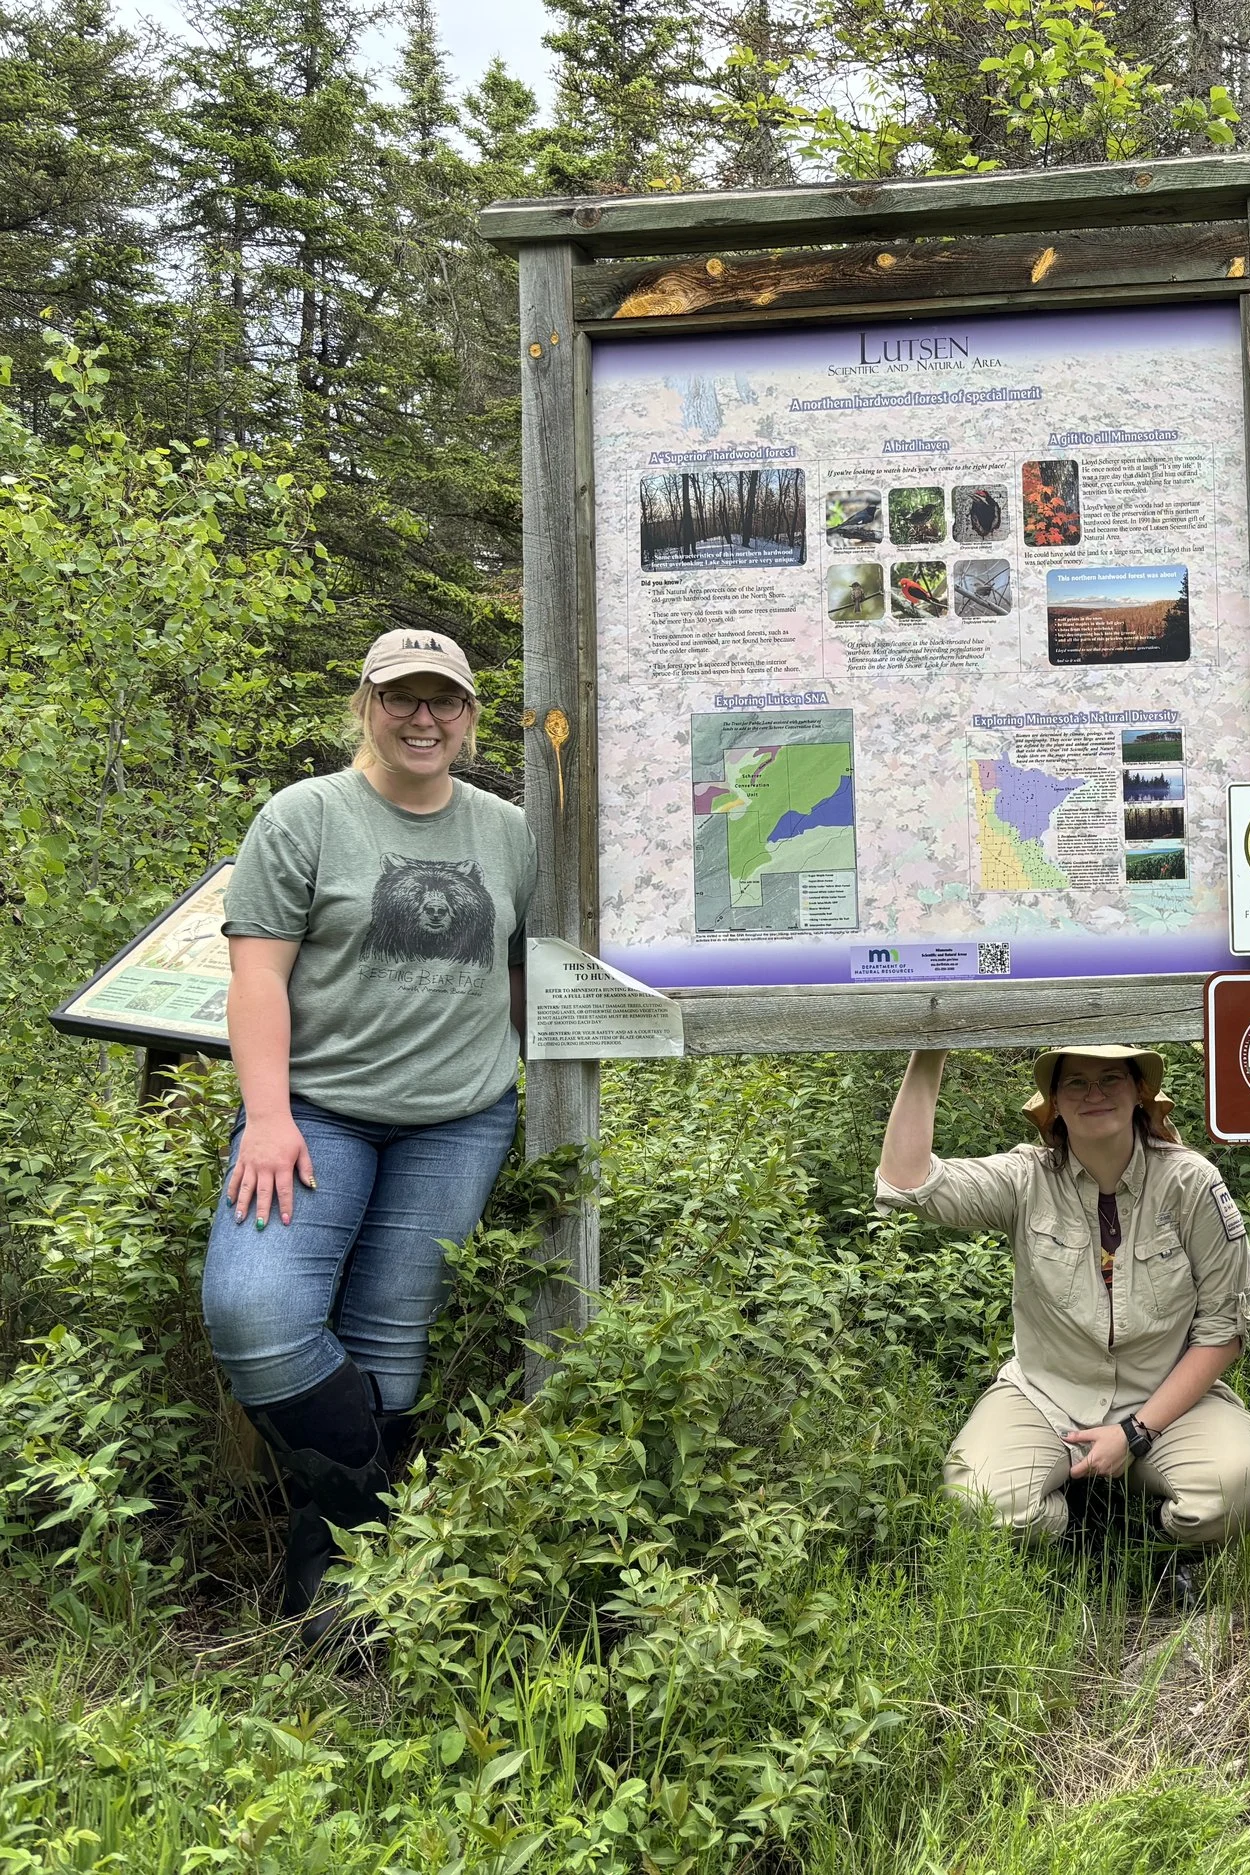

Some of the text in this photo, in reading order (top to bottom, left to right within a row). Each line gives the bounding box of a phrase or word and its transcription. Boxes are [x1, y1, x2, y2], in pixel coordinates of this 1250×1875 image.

[859, 332, 969, 365] LUTSEN
[828, 357, 1002, 377] SCIENTIFIC AND NATURAL AREA
[790, 386, 1041, 411] A northern hardwood forest of special merit
[883, 440, 949, 452] A bird haven
[1049, 429, 1177, 447] A gift to all Minnesotans
[650, 452, 659, 464] A
[713, 447, 762, 461] hardwood
[765, 446, 796, 458] forest
[833, 469, 851, 477] you're
[902, 465, 917, 473] birds
[918, 465, 937, 473] you've
[972, 463, 987, 471] right
[988, 462, 1007, 471] place!
[1163, 546, 1180, 555] Lloyd
[755, 585, 775, 593] largest
[708, 617, 724, 625] years
[715, 692, 828, 708] Exploring Lutsen SNA
[973, 710, 1178, 728] Exploring Minnesota's Natural Diversity
[562, 963, 585, 971] THIS
[358, 964, 486, 989] RESTING BEAR FACE
[574, 972, 615, 981] TO HUN
